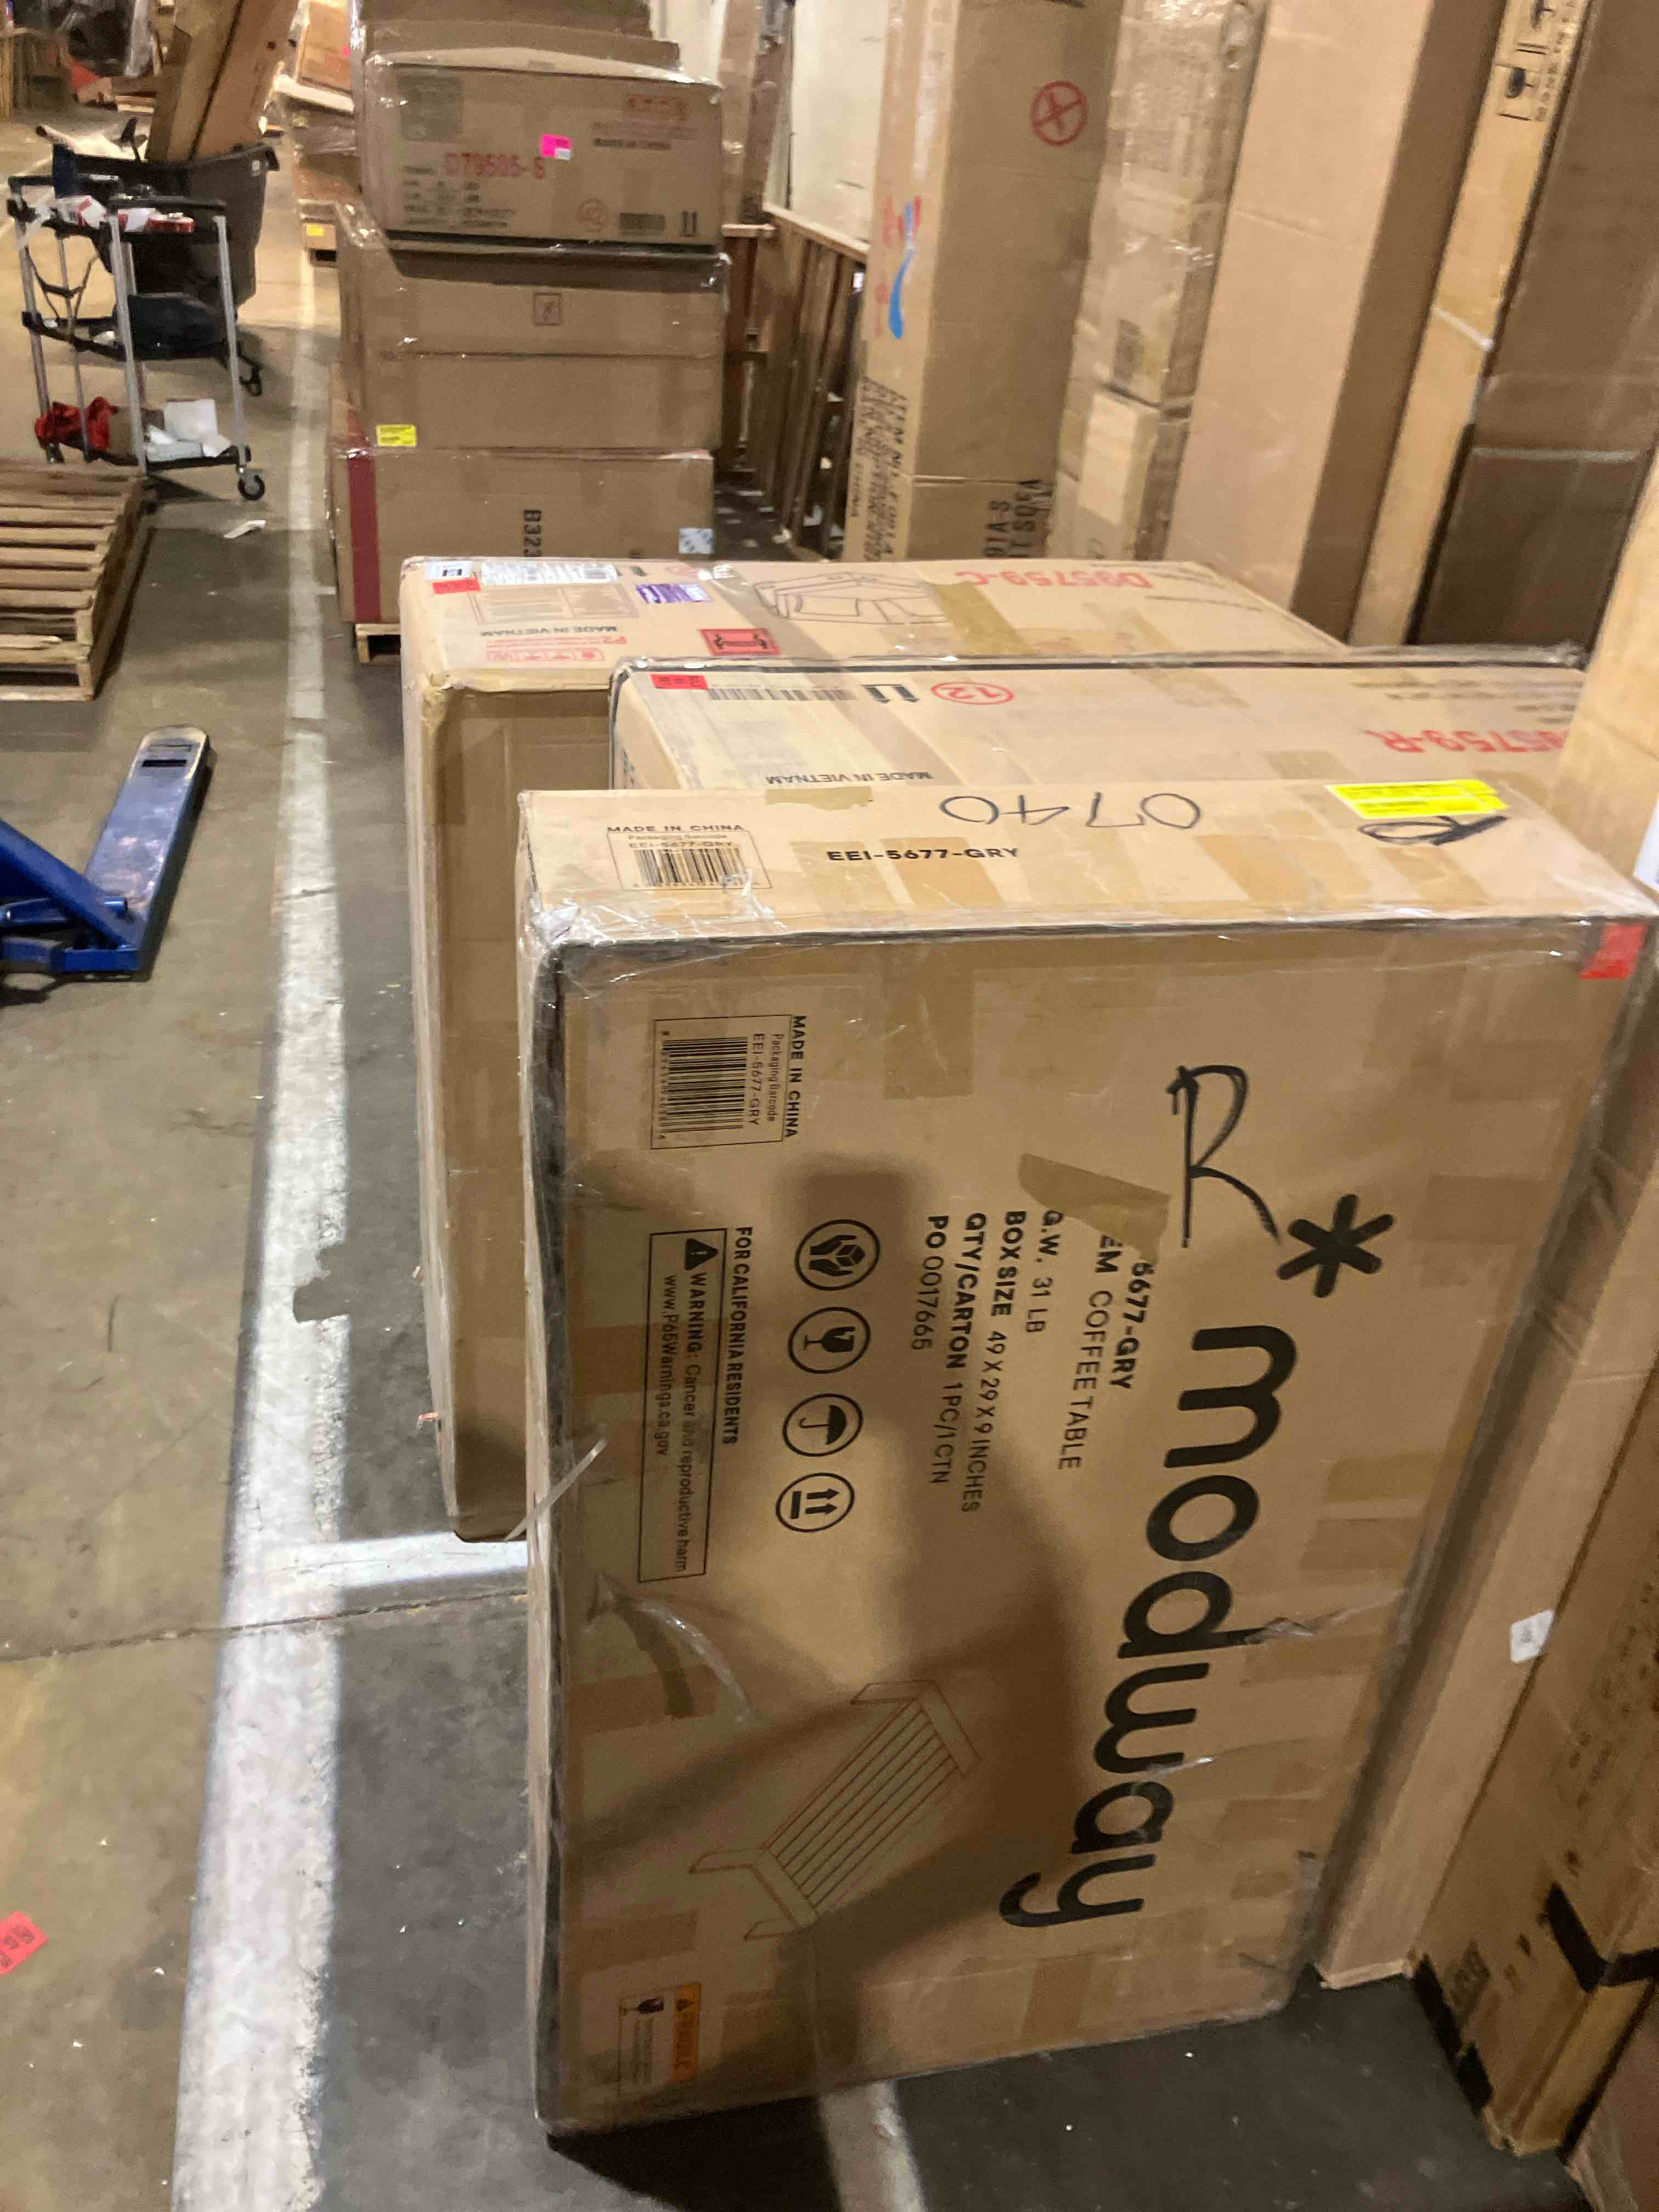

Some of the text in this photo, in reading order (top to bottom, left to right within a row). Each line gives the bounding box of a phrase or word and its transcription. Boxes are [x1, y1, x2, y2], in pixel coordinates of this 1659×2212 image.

[765, 771, 933, 785] MADE IN VIETNAM
[826, 848, 1019, 861] EEI-5677-GRY
[748, 1033, 764, 1125] EEI-5677-GRY
[768, 1034, 785, 1121] Packaging Barcode
[785, 1015, 806, 1137] MADE IN CHINA
[1166, 1065, 1280, 1248] R
[911, 1215, 949, 1351] PO 0017665
[1025, 1209, 1063, 1333] G.W. 31 LB
[722, 1226, 753, 1444] FOR CALIFORNIA RESIDENTS
[930, 1212, 987, 1483] QTY/CARTON 1PC/1CTN
[960, 1210, 1027, 1513] BOX SIZE 49 X 29 X 9 INCHES
[1072, 1289, 1113, 1392] COFFEE
[1109, 1261, 1154, 1390] 5677-GRY
[682, 1420, 697, 1451] and
[684, 1364, 702, 1417] Cancer
[1057, 1395, 1093, 1470] TABLE
[675, 1454, 695, 1537] reproductive
[674, 1538, 688, 1572] harm
[996, 1325, 1298, 1928] modway
